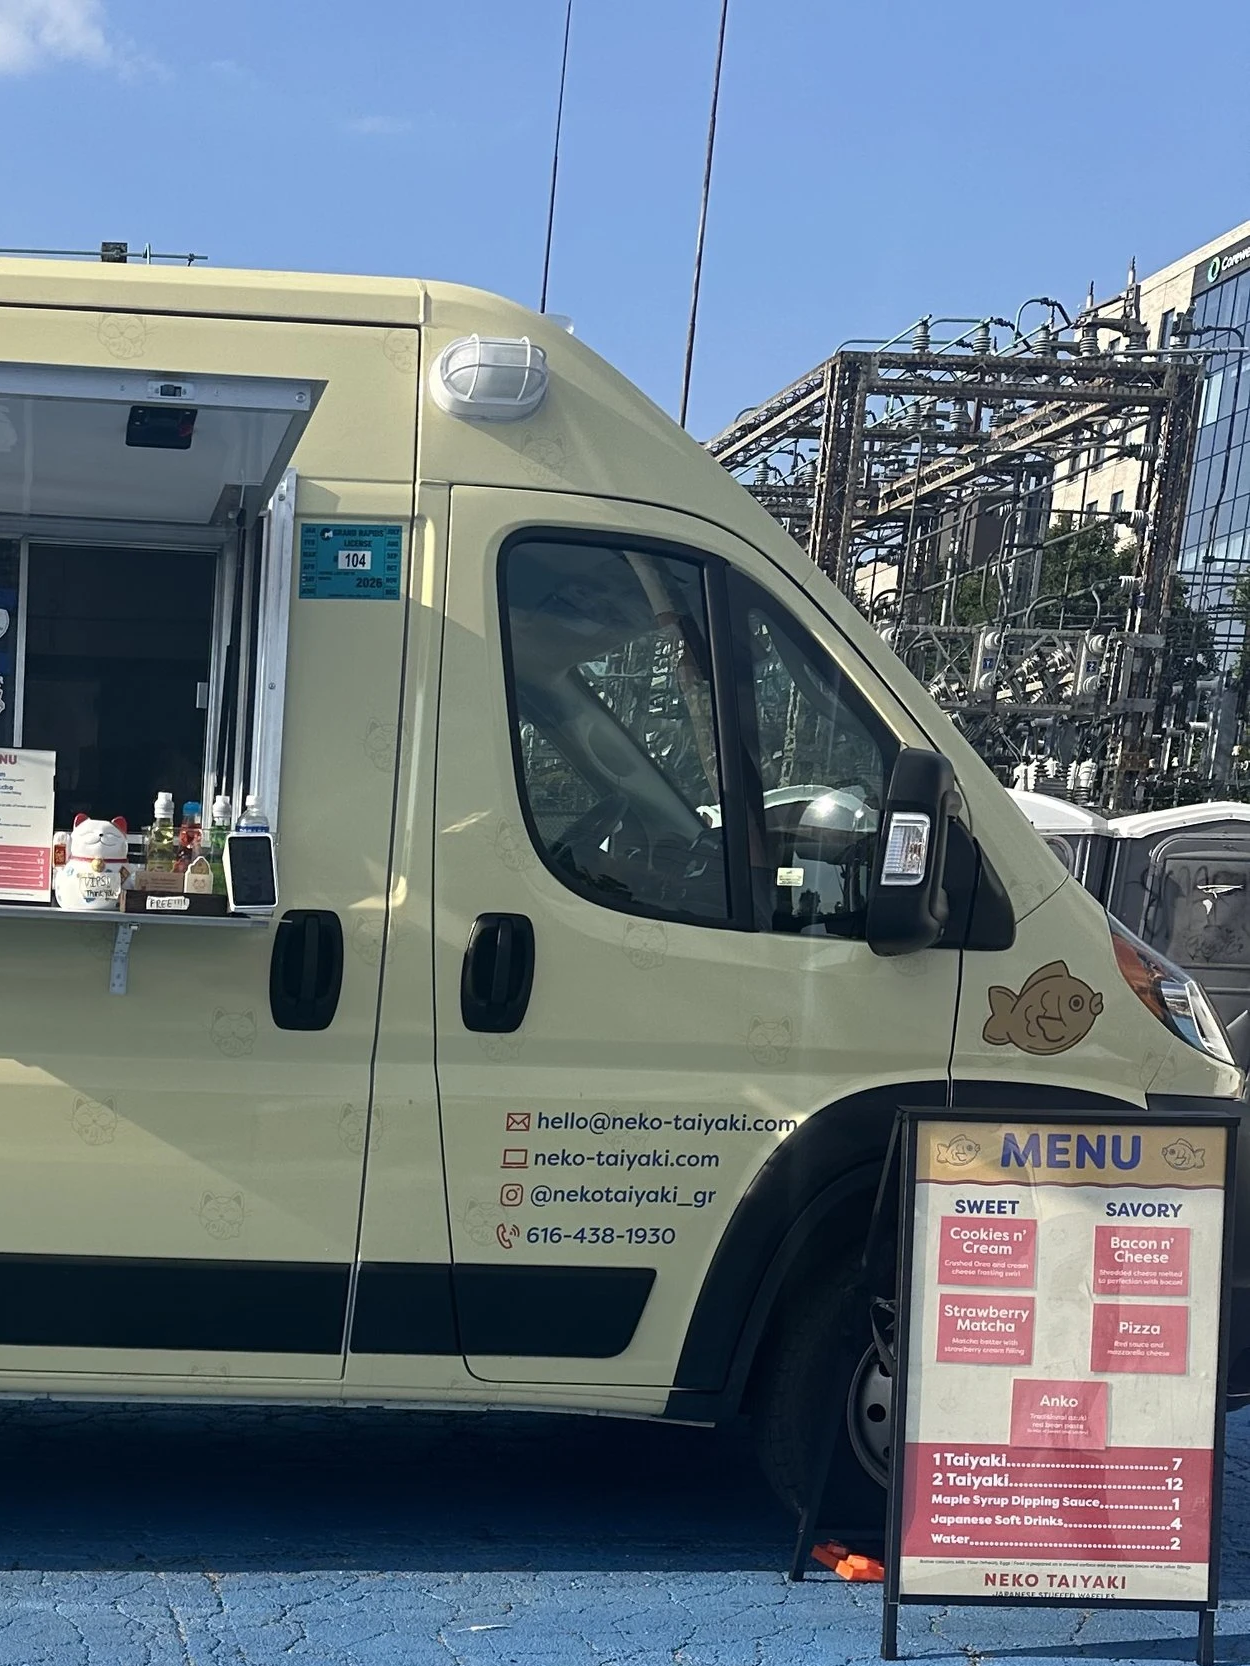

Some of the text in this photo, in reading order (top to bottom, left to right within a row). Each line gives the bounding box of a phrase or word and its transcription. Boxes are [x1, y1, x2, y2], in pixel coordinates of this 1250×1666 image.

[345, 553, 366, 568] 104
[356, 577, 383, 588] 2026
[537, 1111, 798, 1135] hello@neko-taiyaki.com
[1001, 1132, 1141, 1170] MENU
[534, 1148, 720, 1171] neko-taiyaki.com
[530, 1184, 717, 1208] @nekotaiyaki_gr
[955, 1199, 1020, 1215] SWEET
[1105, 1202, 1183, 1218] SAVORY
[526, 1227, 676, 1245] 616-438-1930
[950, 1227, 1009, 1240] Cookies
[962, 1241, 1012, 1255] Cream
[1110, 1237, 1157, 1249] Bacon
[1114, 1250, 1169, 1263] Cheese
[977, 1269, 1004, 1277] frosting
[944, 1304, 1029, 1322] Strawberry
[956, 1319, 1015, 1332] Matcha
[1119, 1321, 1161, 1335] Pizza
[1039, 1395, 1078, 1407] Anko
[932, 1452, 941, 1466] 1
[1172, 1457, 1183, 1471] 7
[932, 1472, 943, 1486] 2
[1165, 1477, 1184, 1491] 12
[931, 1494, 970, 1507] Maple
[972, 1495, 1009, 1507] Syrup
[1011, 1495, 1060, 1509] Dipping
[1172, 1497, 1180, 1511] 1
[930, 1513, 992, 1526] Japanese
[994, 1515, 1021, 1525] Soft
[1170, 1517, 1183, 1531] 4
[1170, 1537, 1181, 1550] 2
[984, 1573, 1126, 1589] NEKO TAIYAKI
